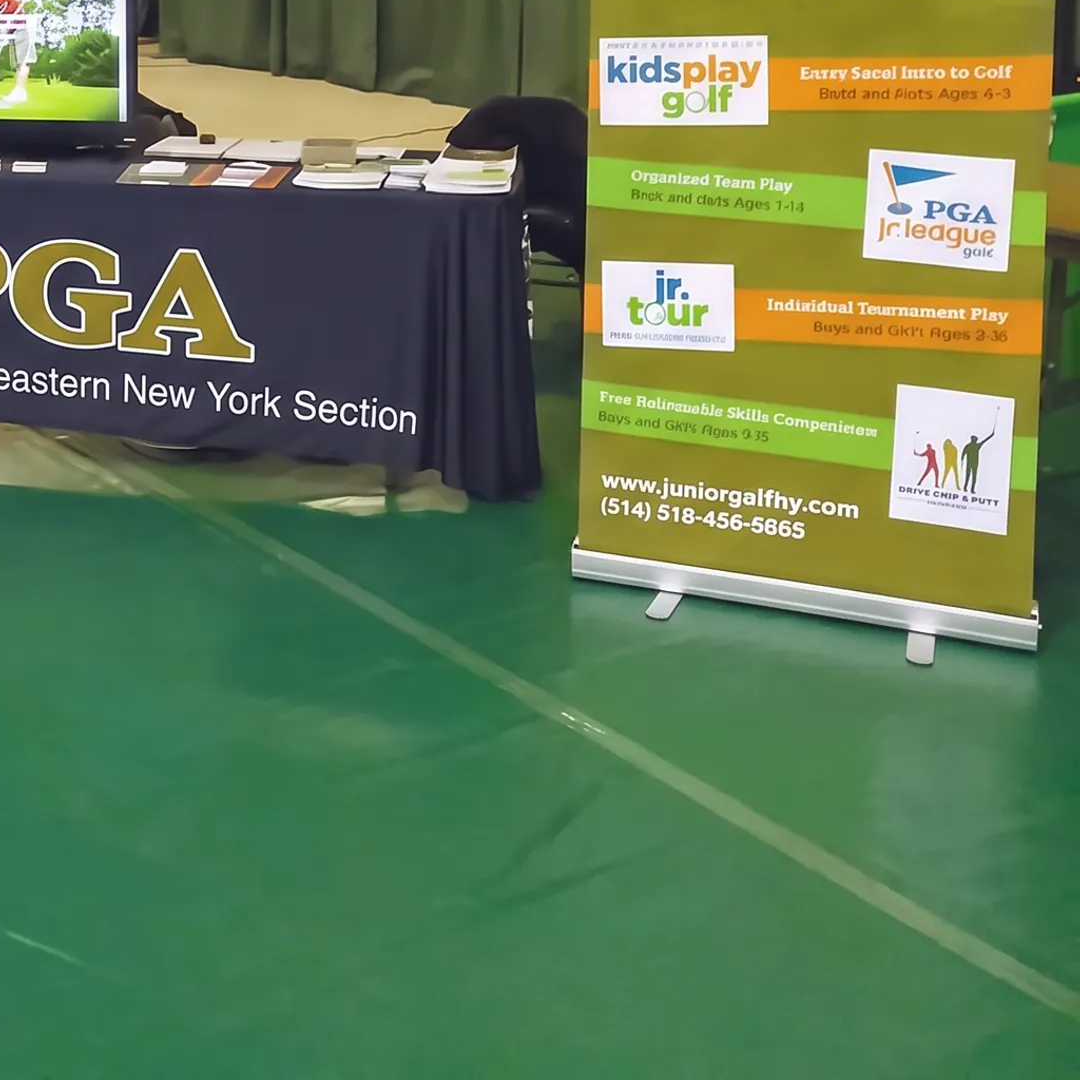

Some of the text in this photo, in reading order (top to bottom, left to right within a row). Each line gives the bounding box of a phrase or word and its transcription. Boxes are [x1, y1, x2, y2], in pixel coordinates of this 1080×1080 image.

[607, 54, 762, 89] kidsplay
[950, 66, 969, 80] to
[661, 84, 733, 119] golf
[862, 87, 890, 100] and
[937, 88, 978, 102] Ages
[631, 169, 793, 195] Organized Team Play
[668, 193, 692, 205] and
[734, 198, 770, 212] Ages
[923, 200, 997, 224] PGA
[905, 218, 996, 249] league
[656, 270, 689, 304] jr.
[627, 296, 709, 327] tour
[970, 308, 1009, 325] Play
[855, 324, 882, 335] and
[123, 373, 196, 410] New
[205, 380, 282, 419] York
[293, 390, 418, 436] Section
[599, 390, 632, 406] Free
[726, 406, 770, 424] Skills
[634, 415, 661, 430] and
[600, 496, 651, 521] (514)
